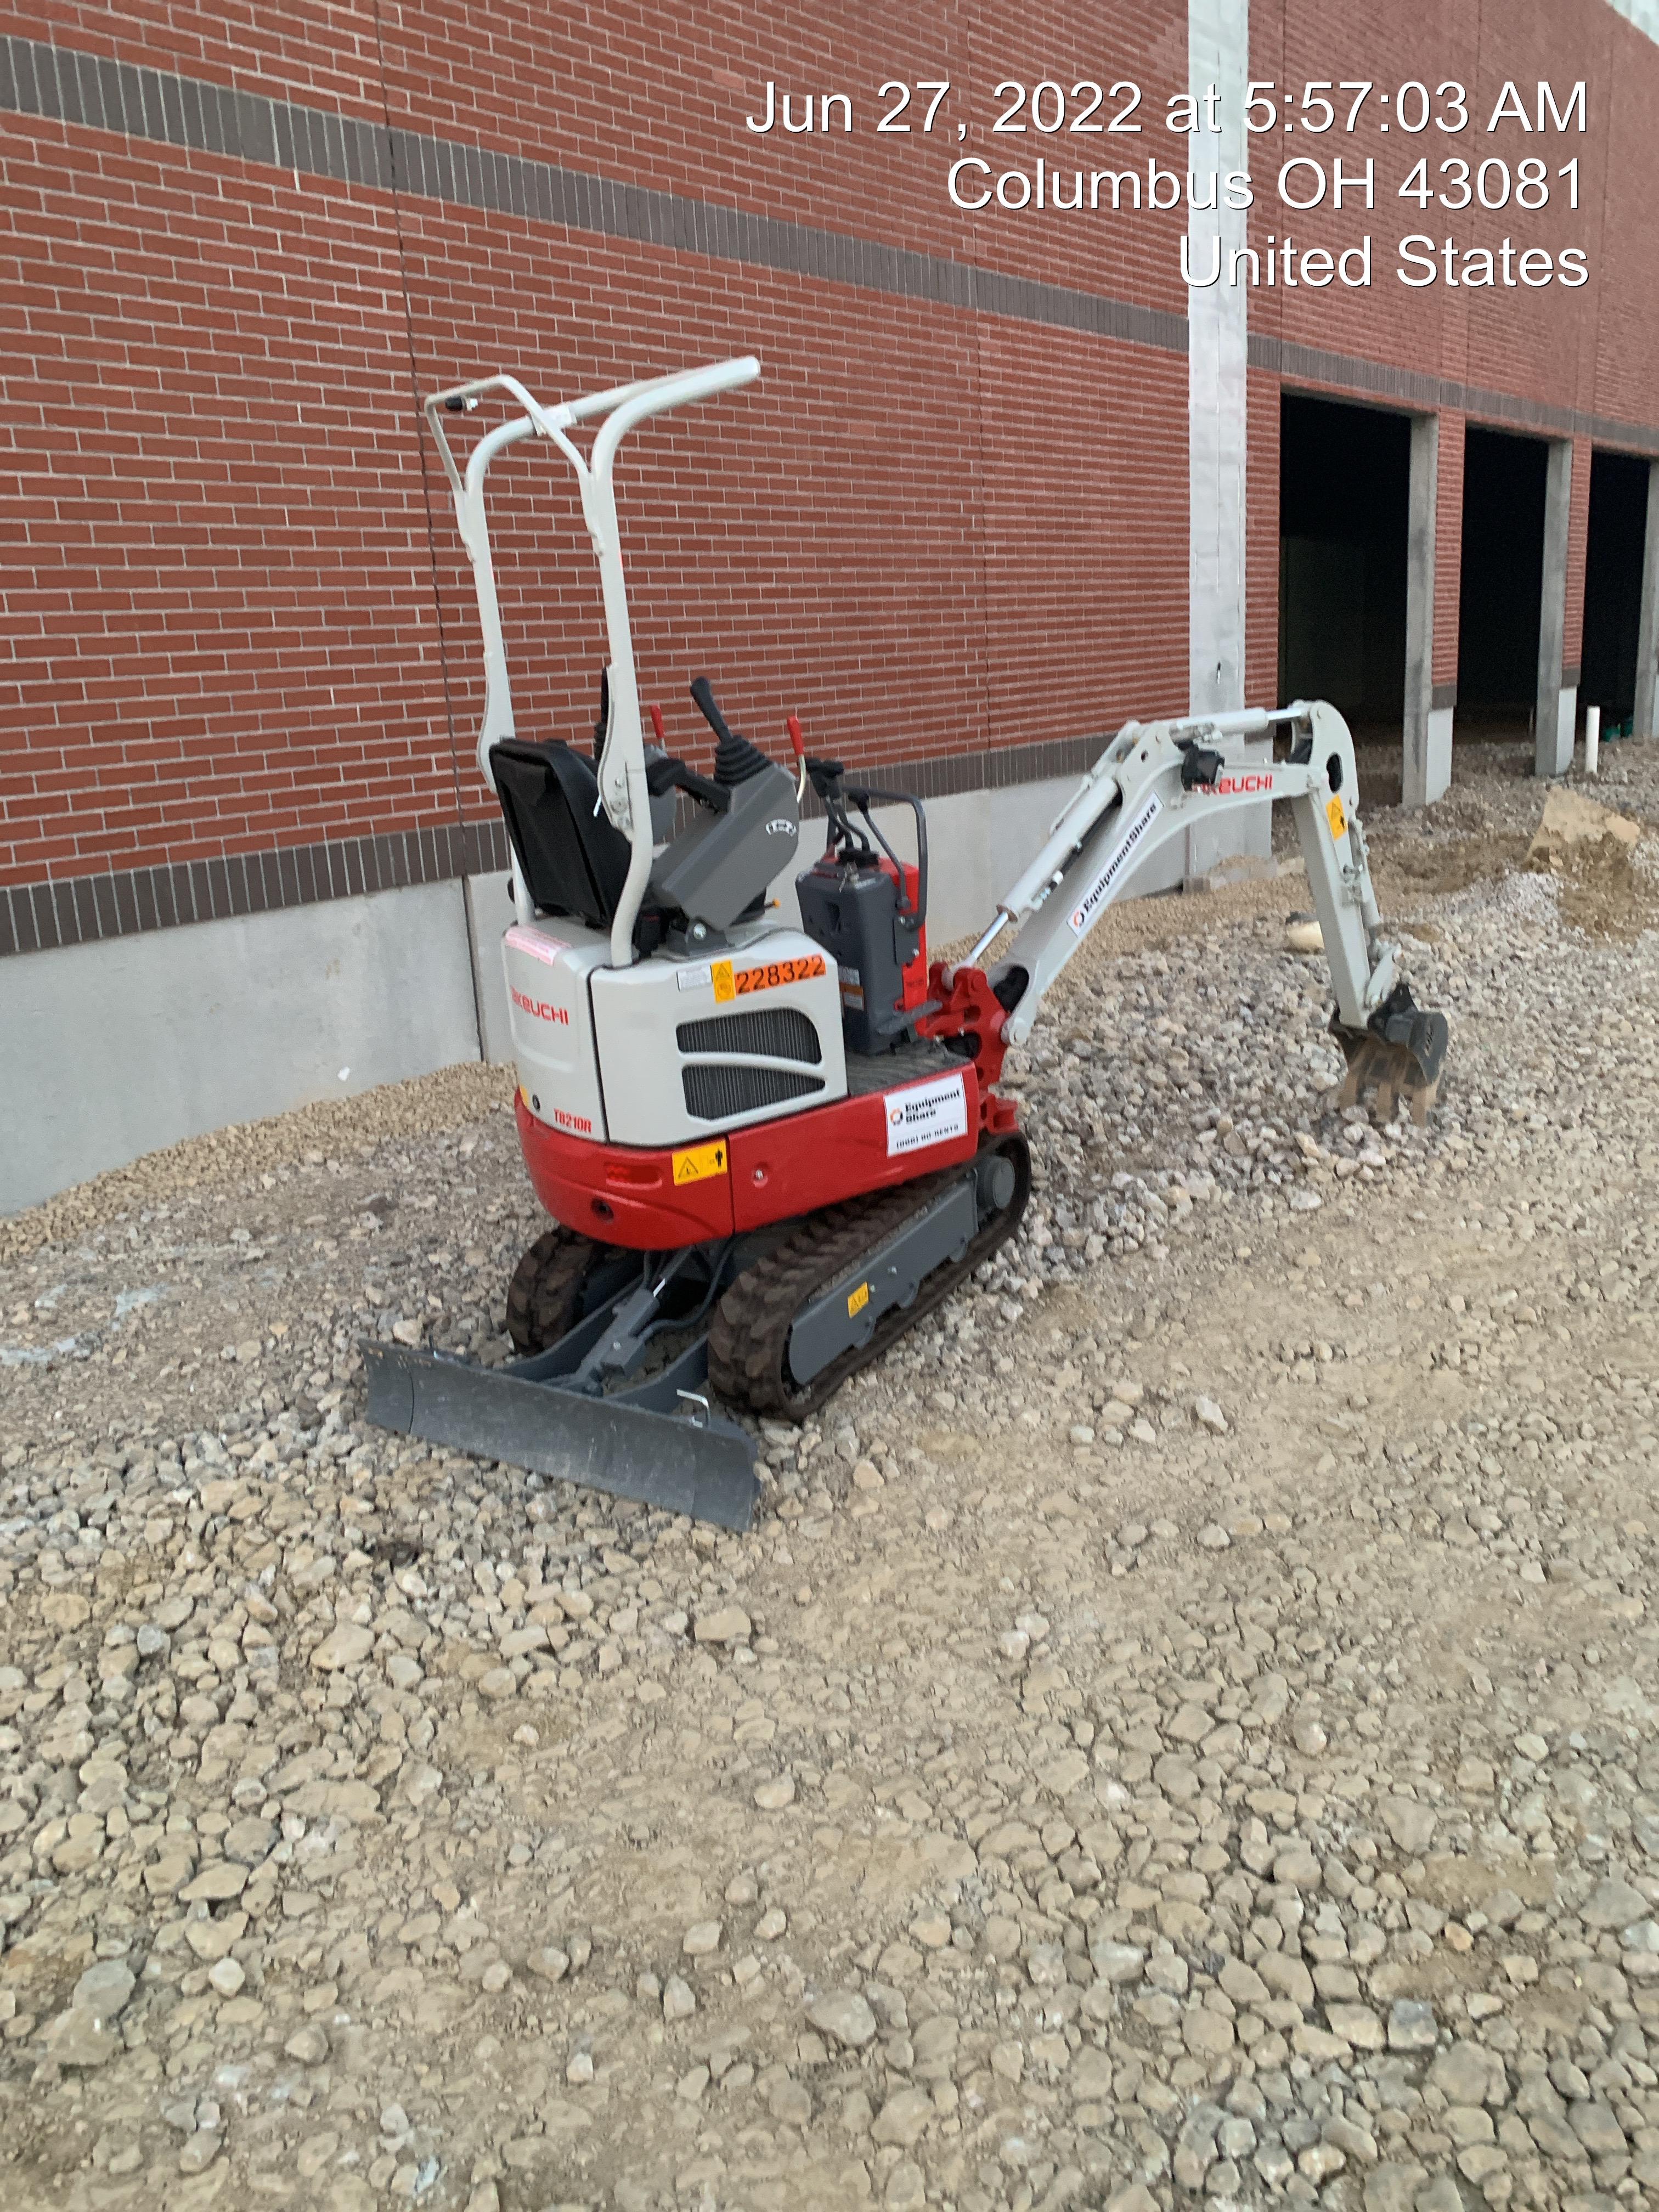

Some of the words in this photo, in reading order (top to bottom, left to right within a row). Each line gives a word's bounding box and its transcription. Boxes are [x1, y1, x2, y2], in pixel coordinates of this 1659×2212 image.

[1083, 803, 1156, 913] EquipmentShare
[736, 956, 825, 995] 228322
[905, 1088, 960, 1112] Equipment
